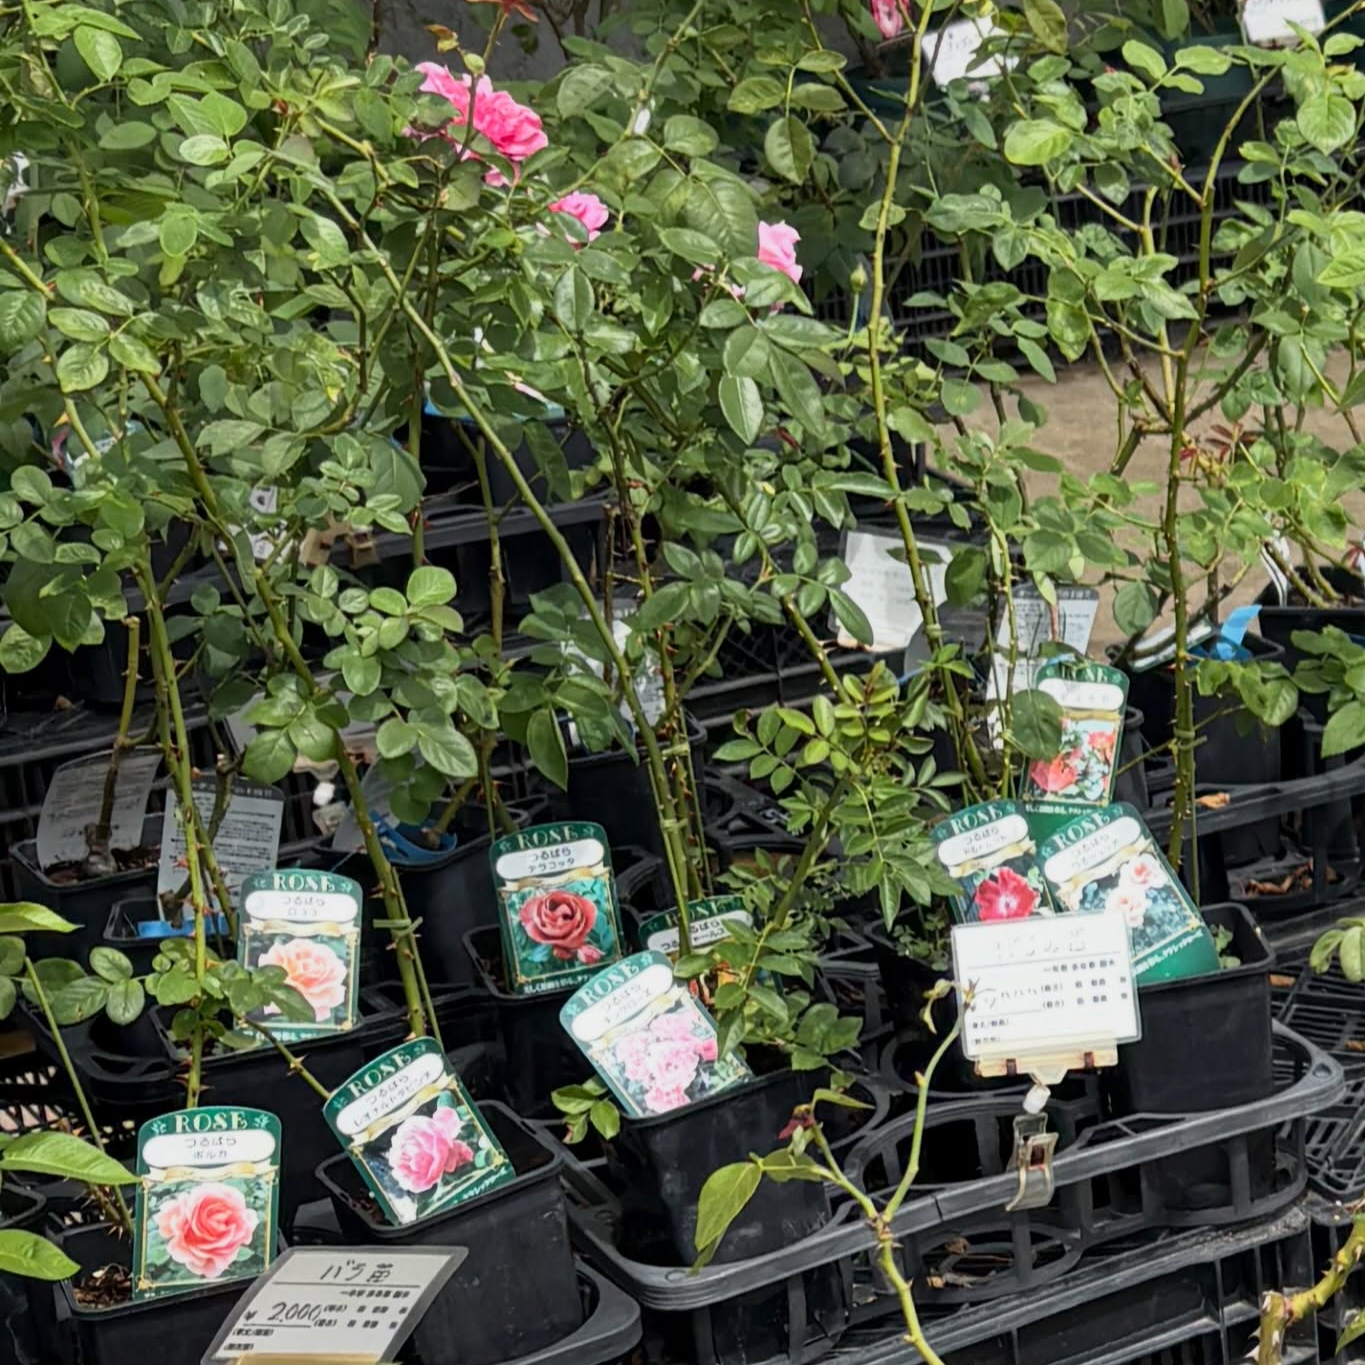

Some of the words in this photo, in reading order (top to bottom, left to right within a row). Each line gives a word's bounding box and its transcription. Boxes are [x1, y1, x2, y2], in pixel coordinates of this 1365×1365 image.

[949, 803, 1004, 836] ROSE
[1052, 810, 1111, 850] ROSE
[517, 825, 579, 851] ROSE
[272, 873, 336, 892] ROSE
[579, 960, 641, 1007] ROSE
[347, 1049, 413, 1099] ROSE
[174, 1110, 248, 1133] ROSE
[185, 1136, 237, 1149] つるばら
